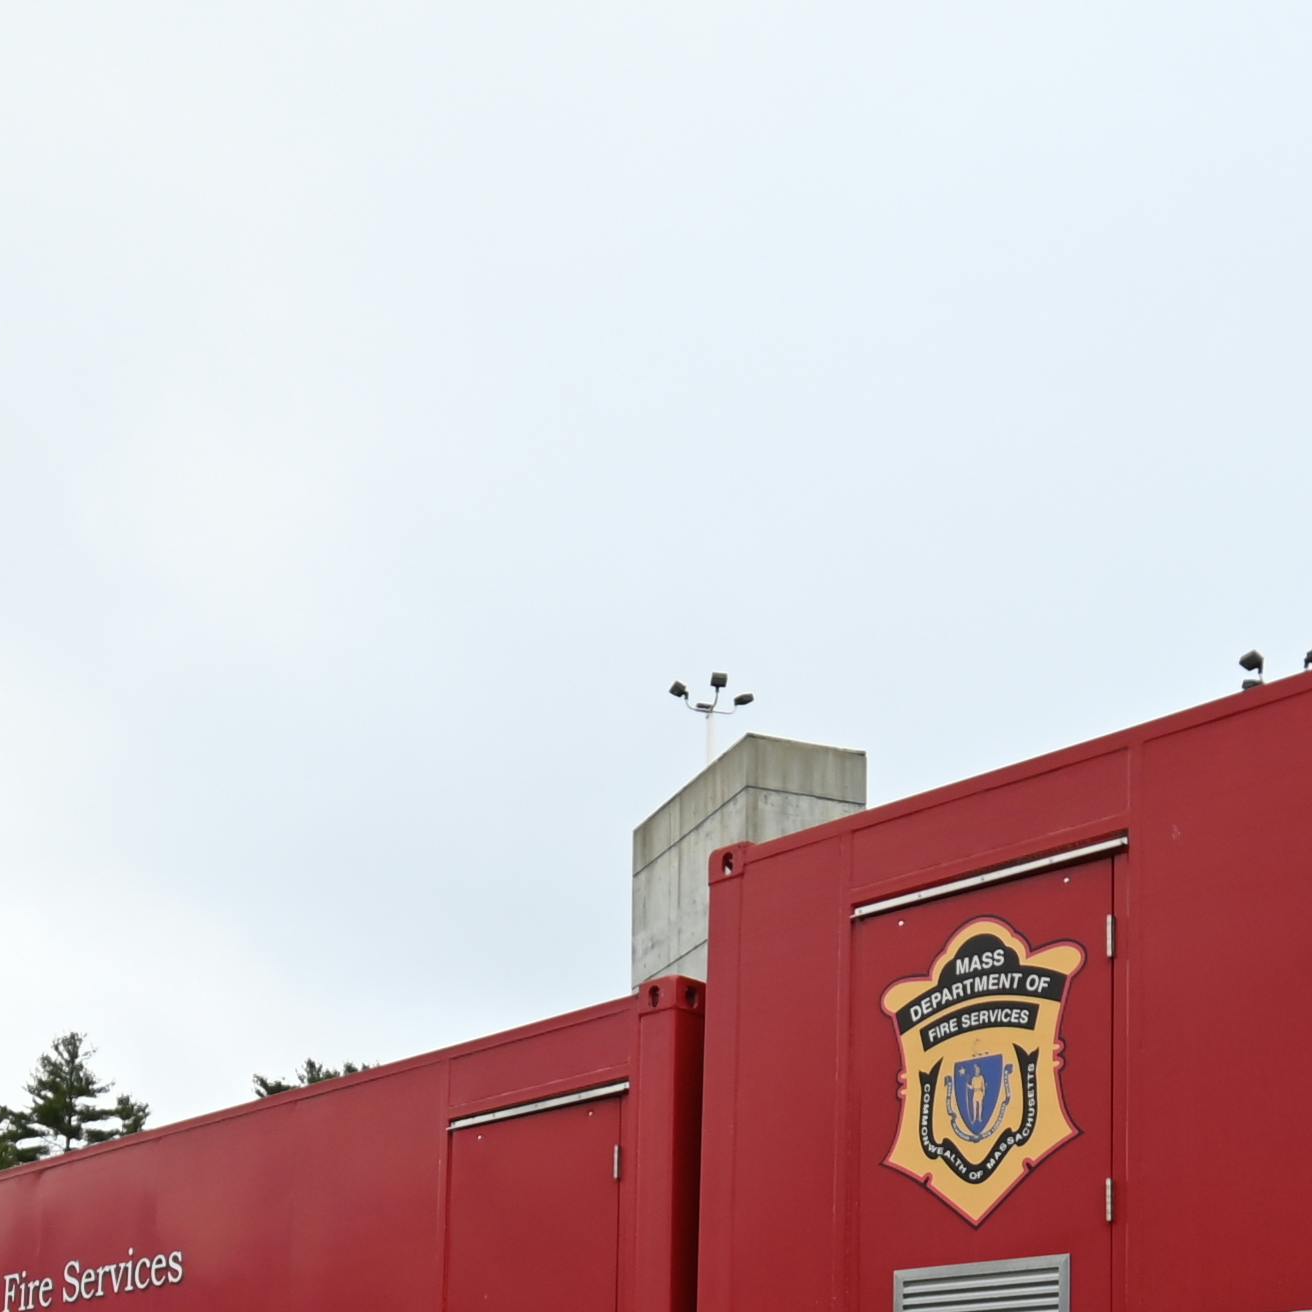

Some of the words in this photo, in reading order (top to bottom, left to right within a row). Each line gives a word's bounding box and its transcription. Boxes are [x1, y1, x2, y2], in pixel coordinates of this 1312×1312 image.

[955, 949, 1005, 976] MASS
[910, 973, 1023, 1022] DEPARTMENT
[1026, 974, 1051, 993] OF
[928, 1018, 959, 1042] FIRE
[961, 1008, 1029, 1027] SERVICES
[921, 1083, 967, 1174] COMMONWEALTH
[969, 1170, 983, 1180] OF
[986, 1063, 1035, 1170] MASSACHUSETTS
[62, 1248, 183, 1303] Services
